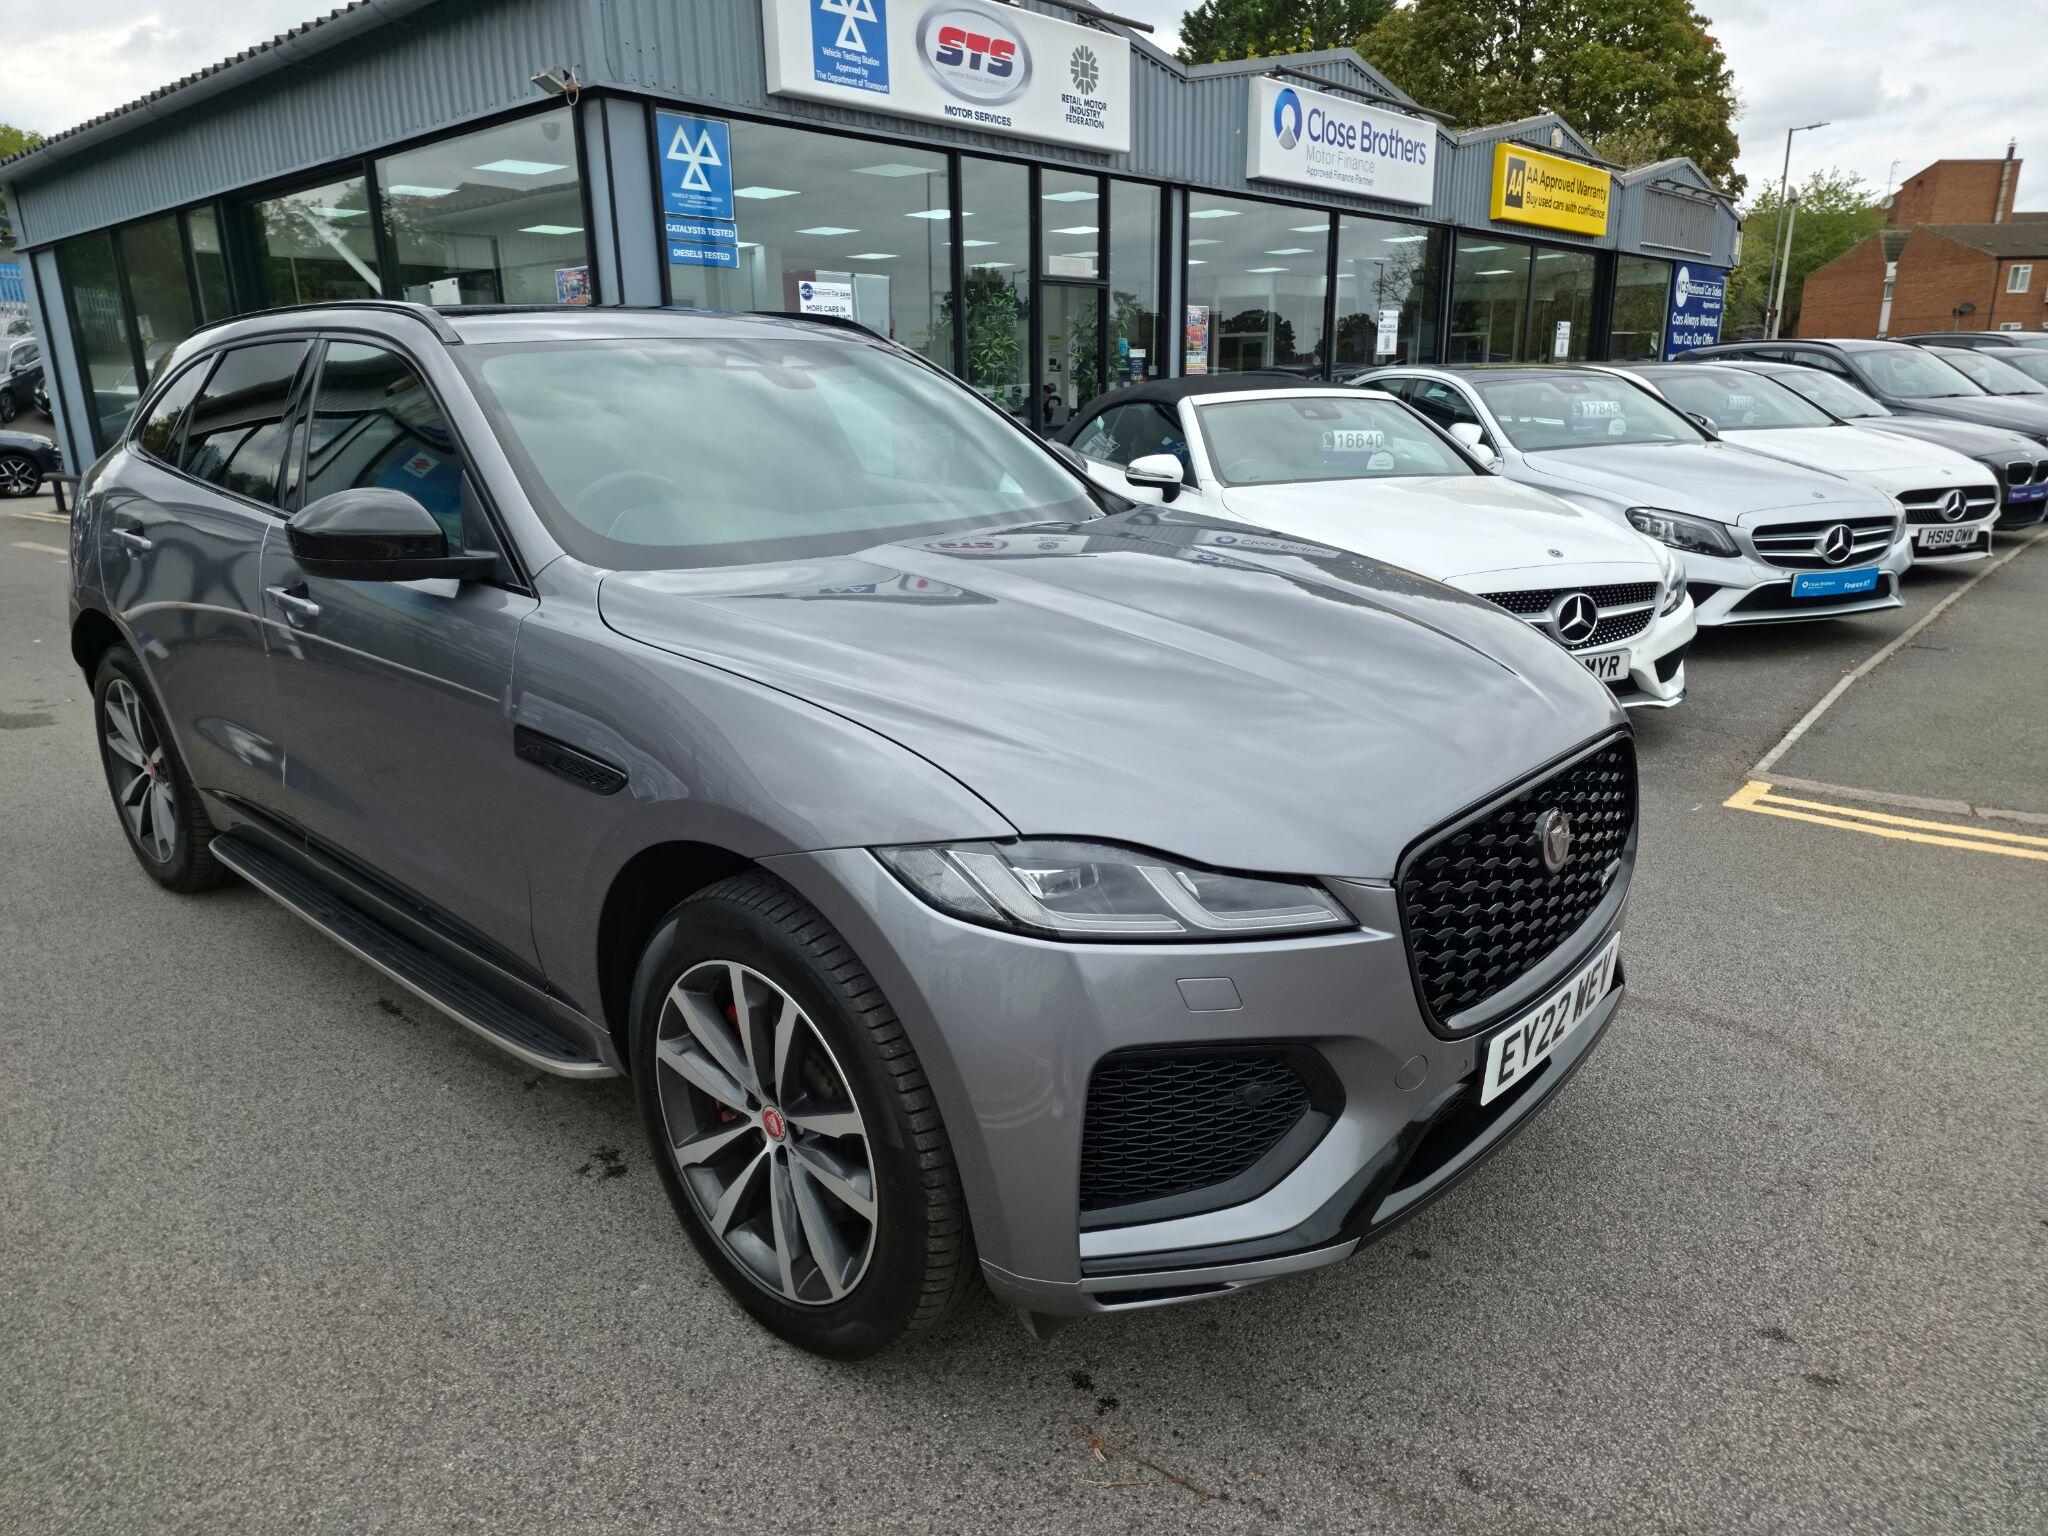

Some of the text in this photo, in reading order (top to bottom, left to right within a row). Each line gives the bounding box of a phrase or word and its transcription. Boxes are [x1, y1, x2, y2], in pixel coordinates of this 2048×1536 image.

[822, 46, 880, 67] Vehicle Testing Station
[935, 26, 1016, 78] STS
[836, 61, 868, 78] Approved by
[816, 69, 888, 92] The Department of Transport
[1061, 93, 1108, 111] RETAIL MOTOR
[944, 104, 1012, 127] MOTOR SERVICES
[1065, 113, 1105, 129] FEDERATION
[1069, 105, 1101, 119] INDUSTRY
[1307, 107, 1427, 166] Close Brothers
[1306, 144, 1375, 174] Motor Finance
[1306, 165, 1374, 187] Approved Finance Partner
[1507, 168, 1523, 197] AA
[1526, 166, 1608, 205] AA Approved Warranty
[1526, 191, 1605, 220] Buy used cars with confidence
[665, 223, 735, 238] CATALYSTS TESTED
[673, 248, 731, 261] DIESELS TESTED
[1688, 282, 1705, 295] National
[1712, 285, 1722, 297] Sales
[806, 304, 823, 312] MORE
[1672, 311, 1684, 325] Cars
[1684, 312, 1699, 329] Always
[1673, 331, 1683, 345] Your
[1693, 332, 1702, 345] Our
[1926, 529, 1954, 544] HS19
[1496, 990, 1572, 1088] EY22
